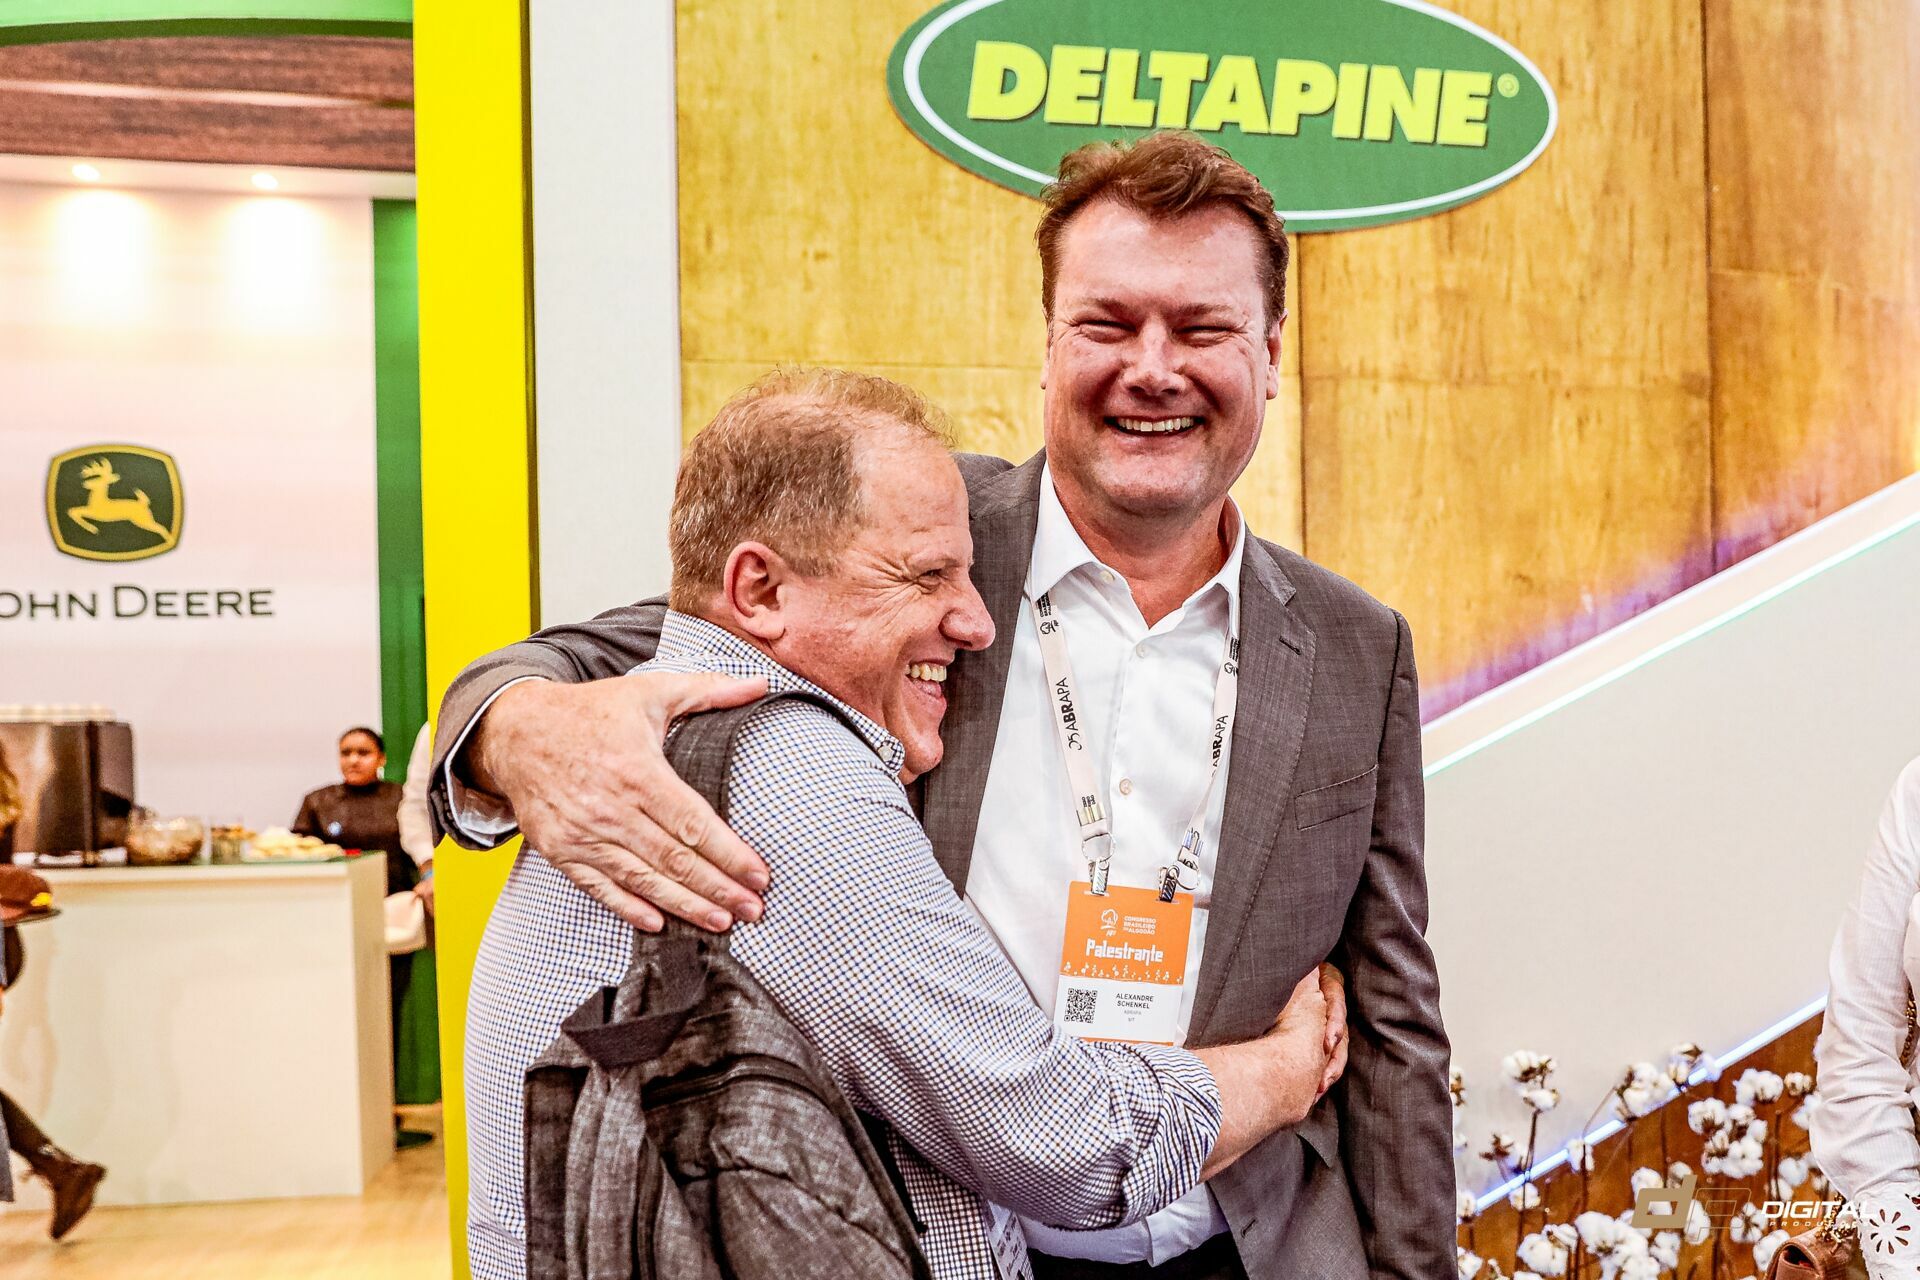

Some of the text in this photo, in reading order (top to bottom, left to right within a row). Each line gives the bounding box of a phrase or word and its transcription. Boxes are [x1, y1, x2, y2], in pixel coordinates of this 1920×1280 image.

[966, 39, 1493, 147] DELTAPINE
[113, 584, 274, 619] DEERE
[1055, 677, 1079, 731] ABRAPA
[1085, 938, 1164, 966] Palestrante
[1115, 993, 1154, 1002] ALEXANDRE
[1117, 1000, 1150, 1009] SCHENKEL
